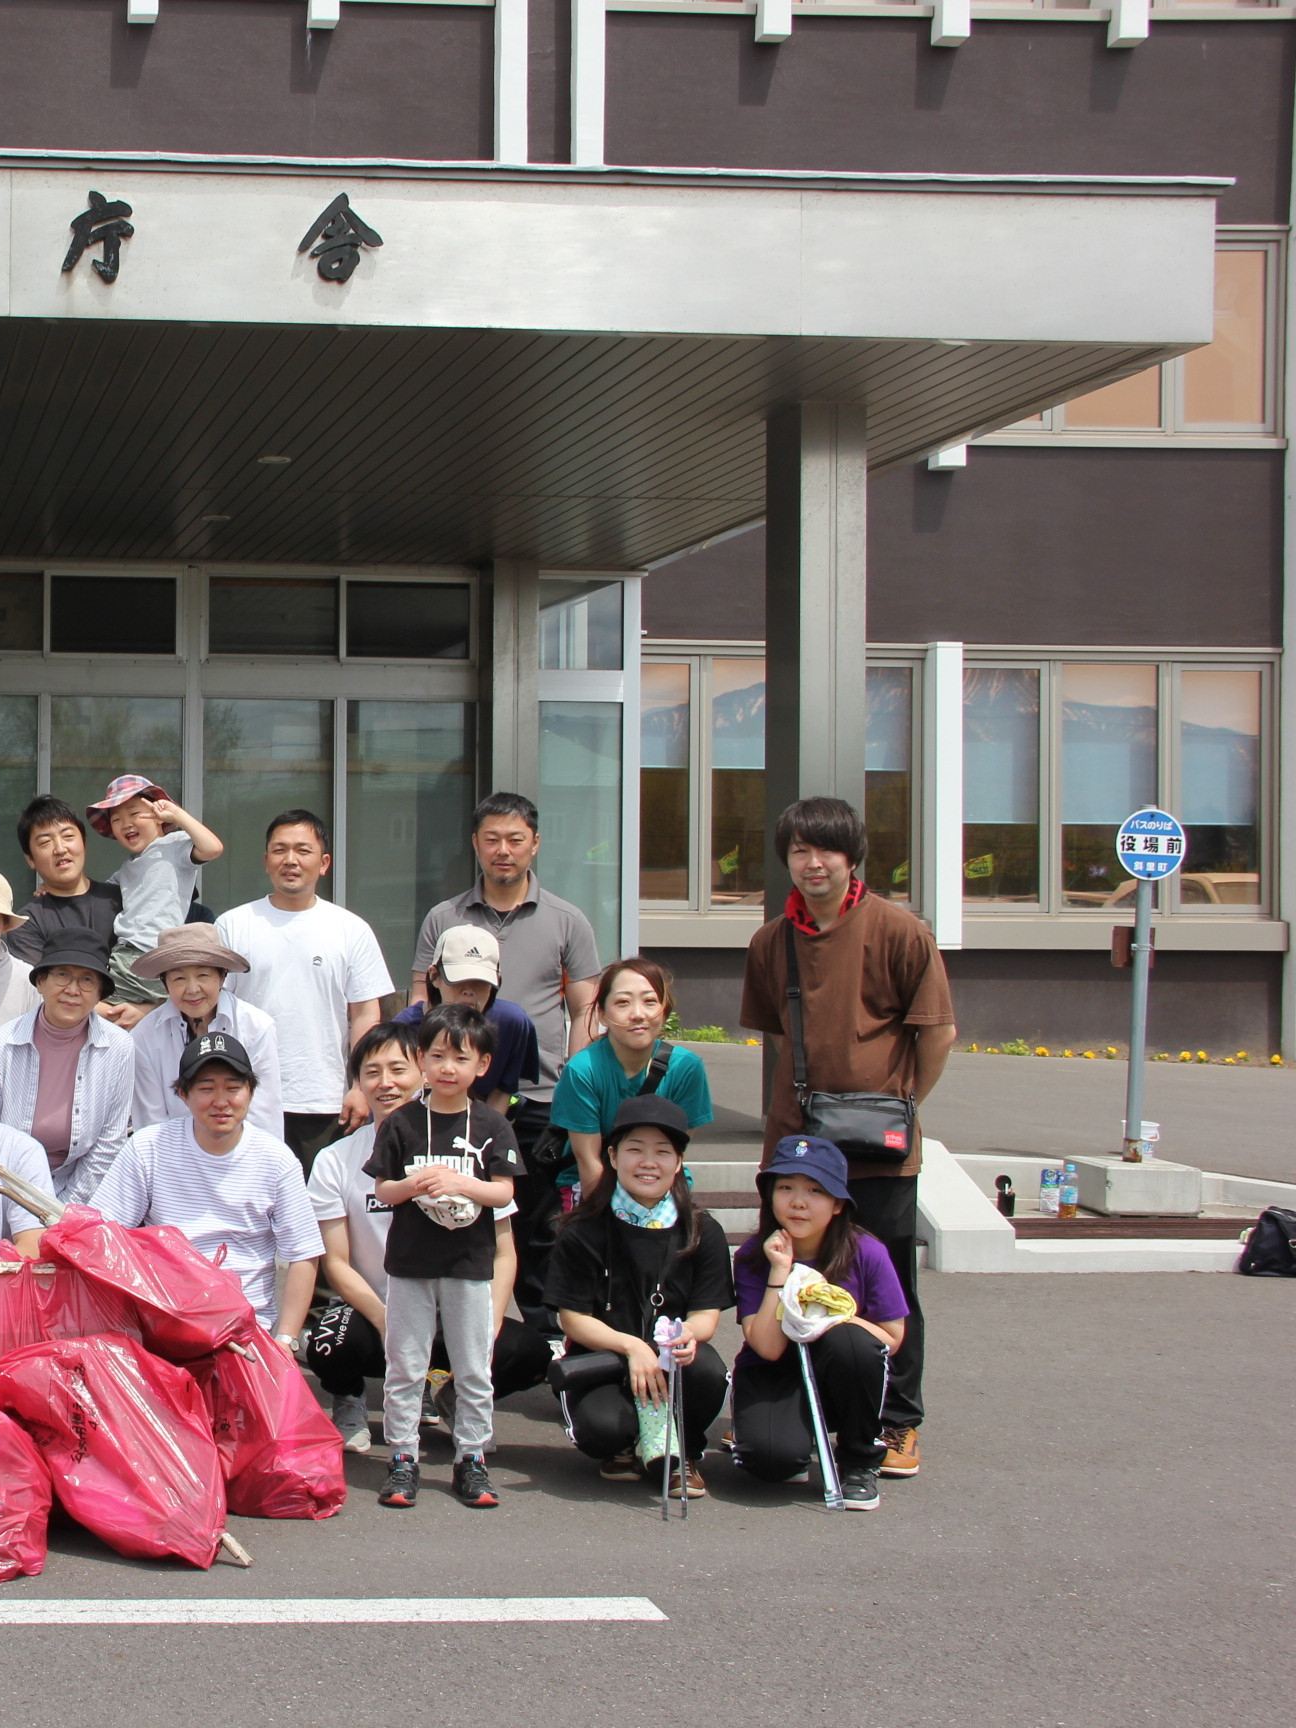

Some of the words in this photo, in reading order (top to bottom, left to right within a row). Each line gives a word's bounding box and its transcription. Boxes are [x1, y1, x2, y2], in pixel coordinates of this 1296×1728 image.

[1130, 820, 1173, 831] バスのりば
[1120, 835, 1182, 854] 役場前
[1133, 861, 1168, 872] 斜里町
